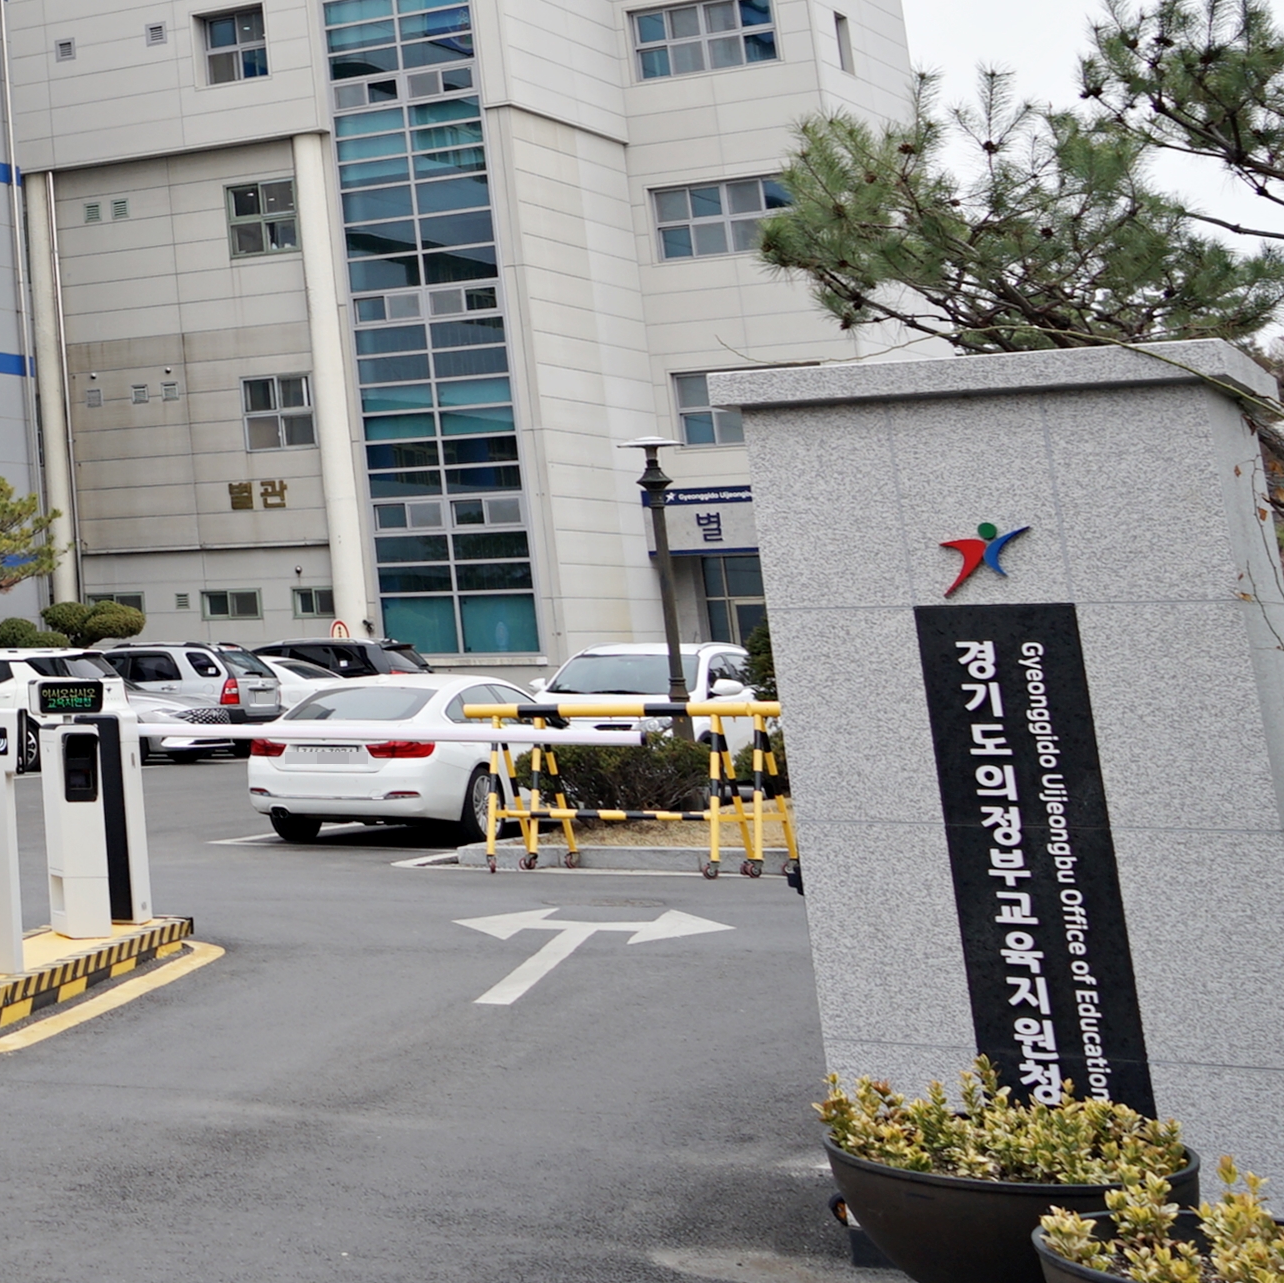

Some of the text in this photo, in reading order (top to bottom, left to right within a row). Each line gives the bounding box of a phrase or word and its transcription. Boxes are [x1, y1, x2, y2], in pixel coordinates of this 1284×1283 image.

[228, 480, 288, 510] 별관
[696, 512, 724, 542] 별
[954, 640, 1063, 1106] 경기도의정부교육지원청
[1018, 641, 1112, 1101] Gyeonggido Uijeongbu Office of Education
